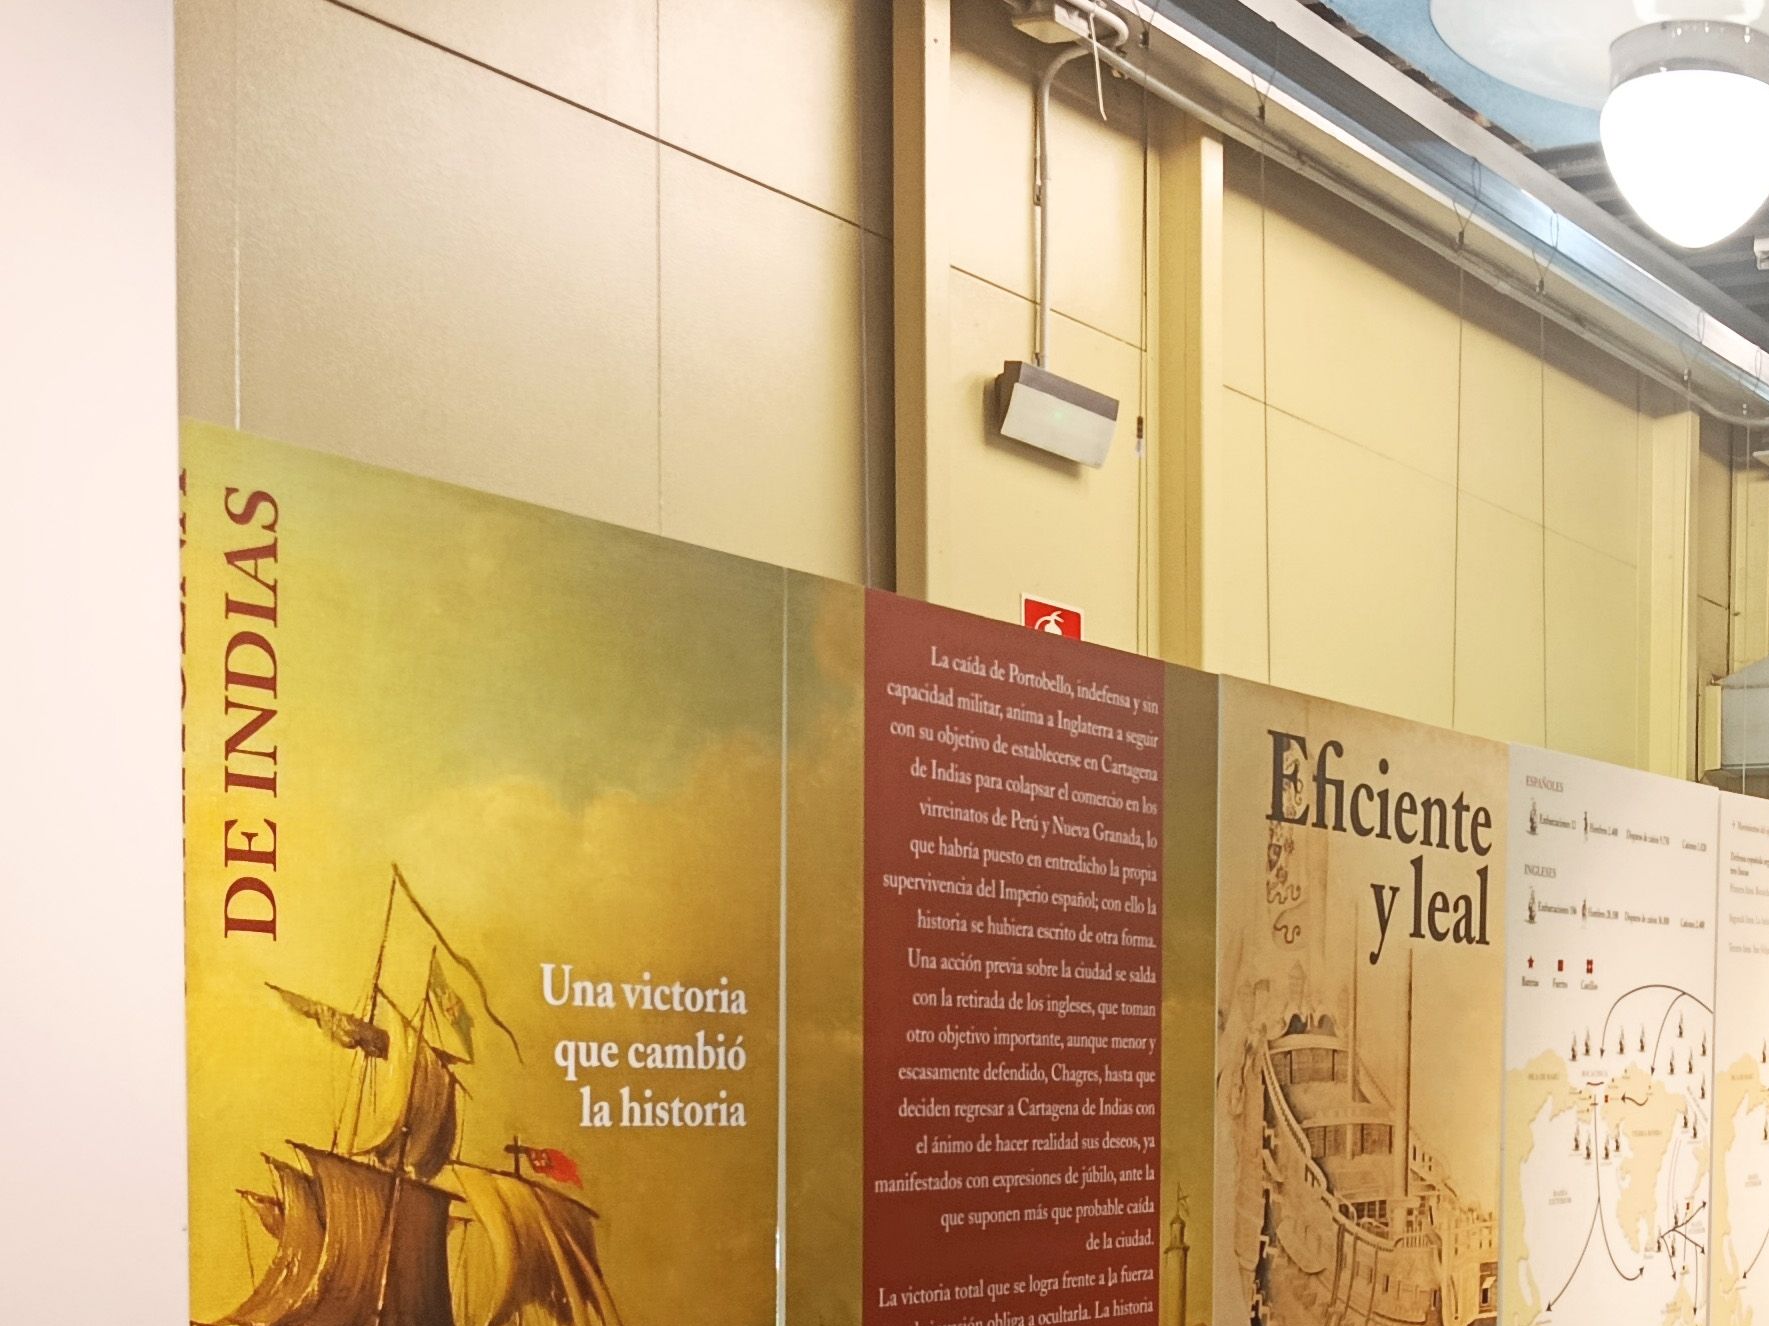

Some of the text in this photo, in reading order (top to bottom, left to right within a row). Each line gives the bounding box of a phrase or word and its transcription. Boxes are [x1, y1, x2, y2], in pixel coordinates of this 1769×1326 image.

[931, 645, 1158, 714] La caída de Portobello, indefensa y sin
[223, 486, 280, 941] DE INDIAS
[886, 682, 1158, 749] capacidad militar, anima a Inglaterra a seguir
[1266, 729, 1492, 856] Eficiente
[917, 908, 1156, 947] historia se hubiera escrito de otra forma.
[1369, 855, 1490, 965] y leal
[542, 963, 747, 1013] Una victoria
[554, 1030, 746, 1080] que cambió
[906, 1024, 1156, 1054] otro objetivo importante, aunque menor y
[580, 1085, 746, 1126] la historia
[898, 1097, 1155, 1122] deciden regresar a Cartagena de Indias con
[940, 1196, 1154, 1232] que suponen más que probable caída
[878, 1264, 1154, 1307] La victoria total que se logra frente a la fuerza
